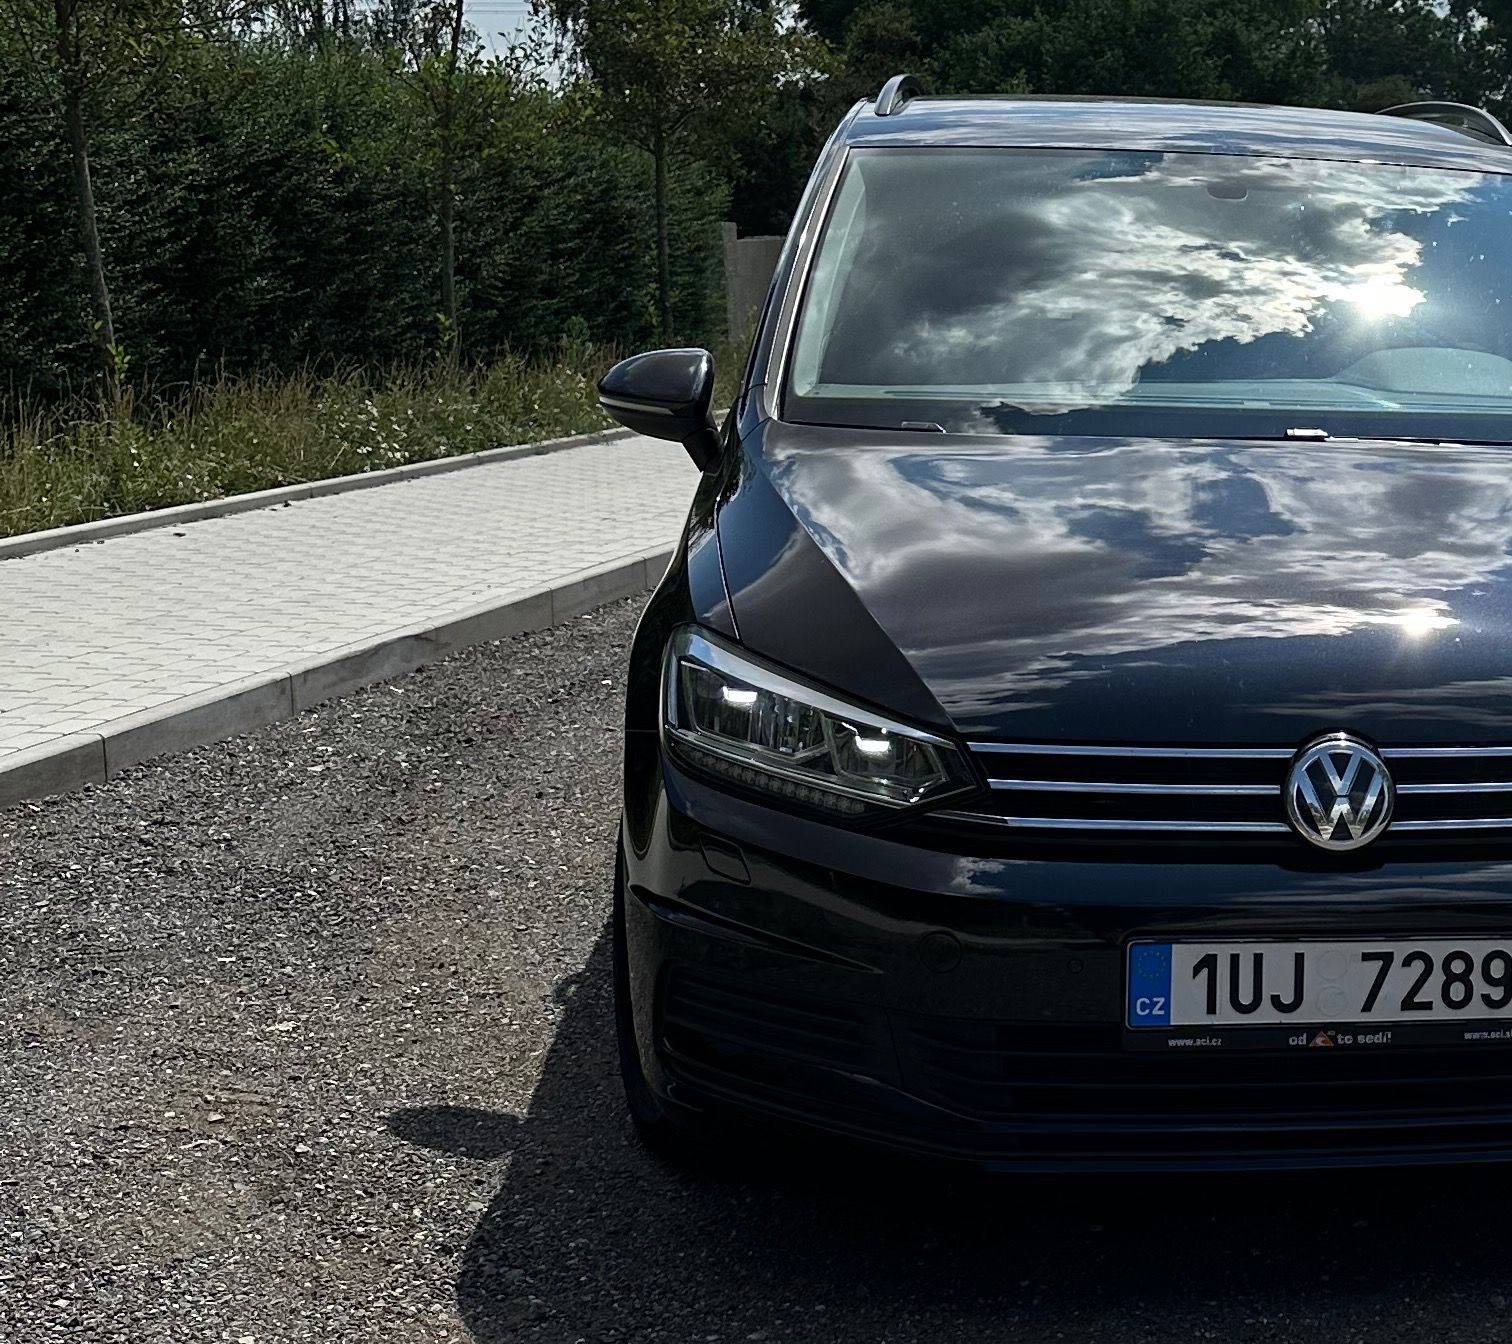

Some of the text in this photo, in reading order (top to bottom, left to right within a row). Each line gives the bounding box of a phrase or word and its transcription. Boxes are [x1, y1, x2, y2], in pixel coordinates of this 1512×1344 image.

[1192, 952, 1305, 1015] 1UJ
[1136, 998, 1166, 1016] CZ
[1289, 1032, 1307, 1045] od
[1337, 1033, 1353, 1044] to
